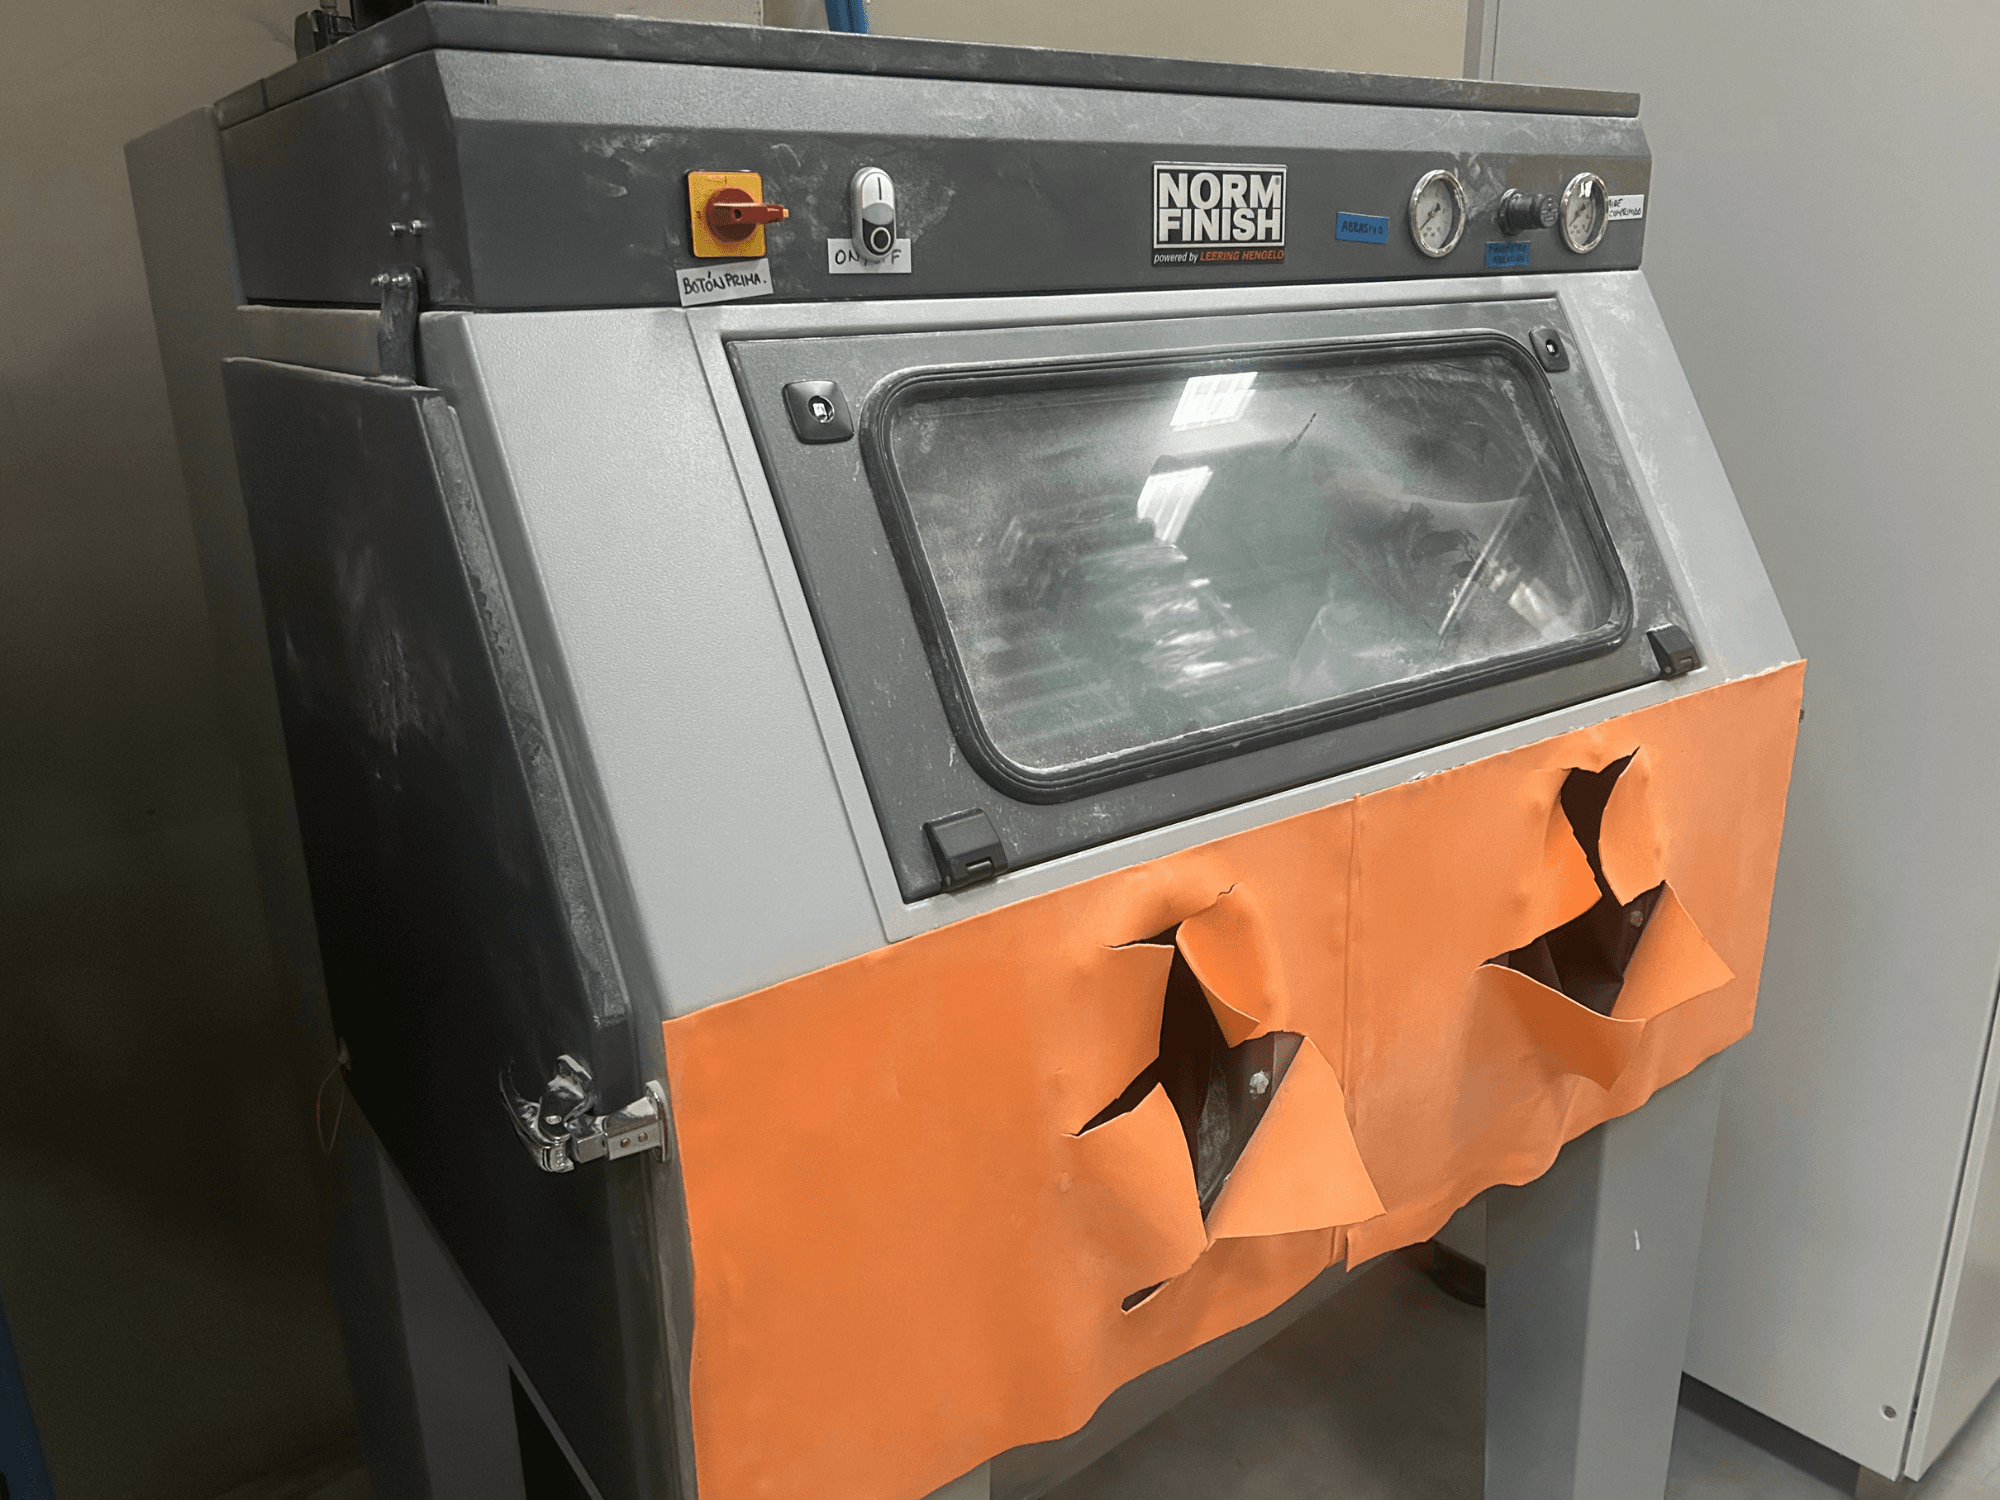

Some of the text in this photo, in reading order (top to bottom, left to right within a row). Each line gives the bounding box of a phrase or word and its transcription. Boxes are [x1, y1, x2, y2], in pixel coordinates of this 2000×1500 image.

[1159, 172, 1282, 210] NORM
[1159, 208, 1281, 241] FINISH
[1154, 249, 1285, 264] powered by LEERING HENGELO
